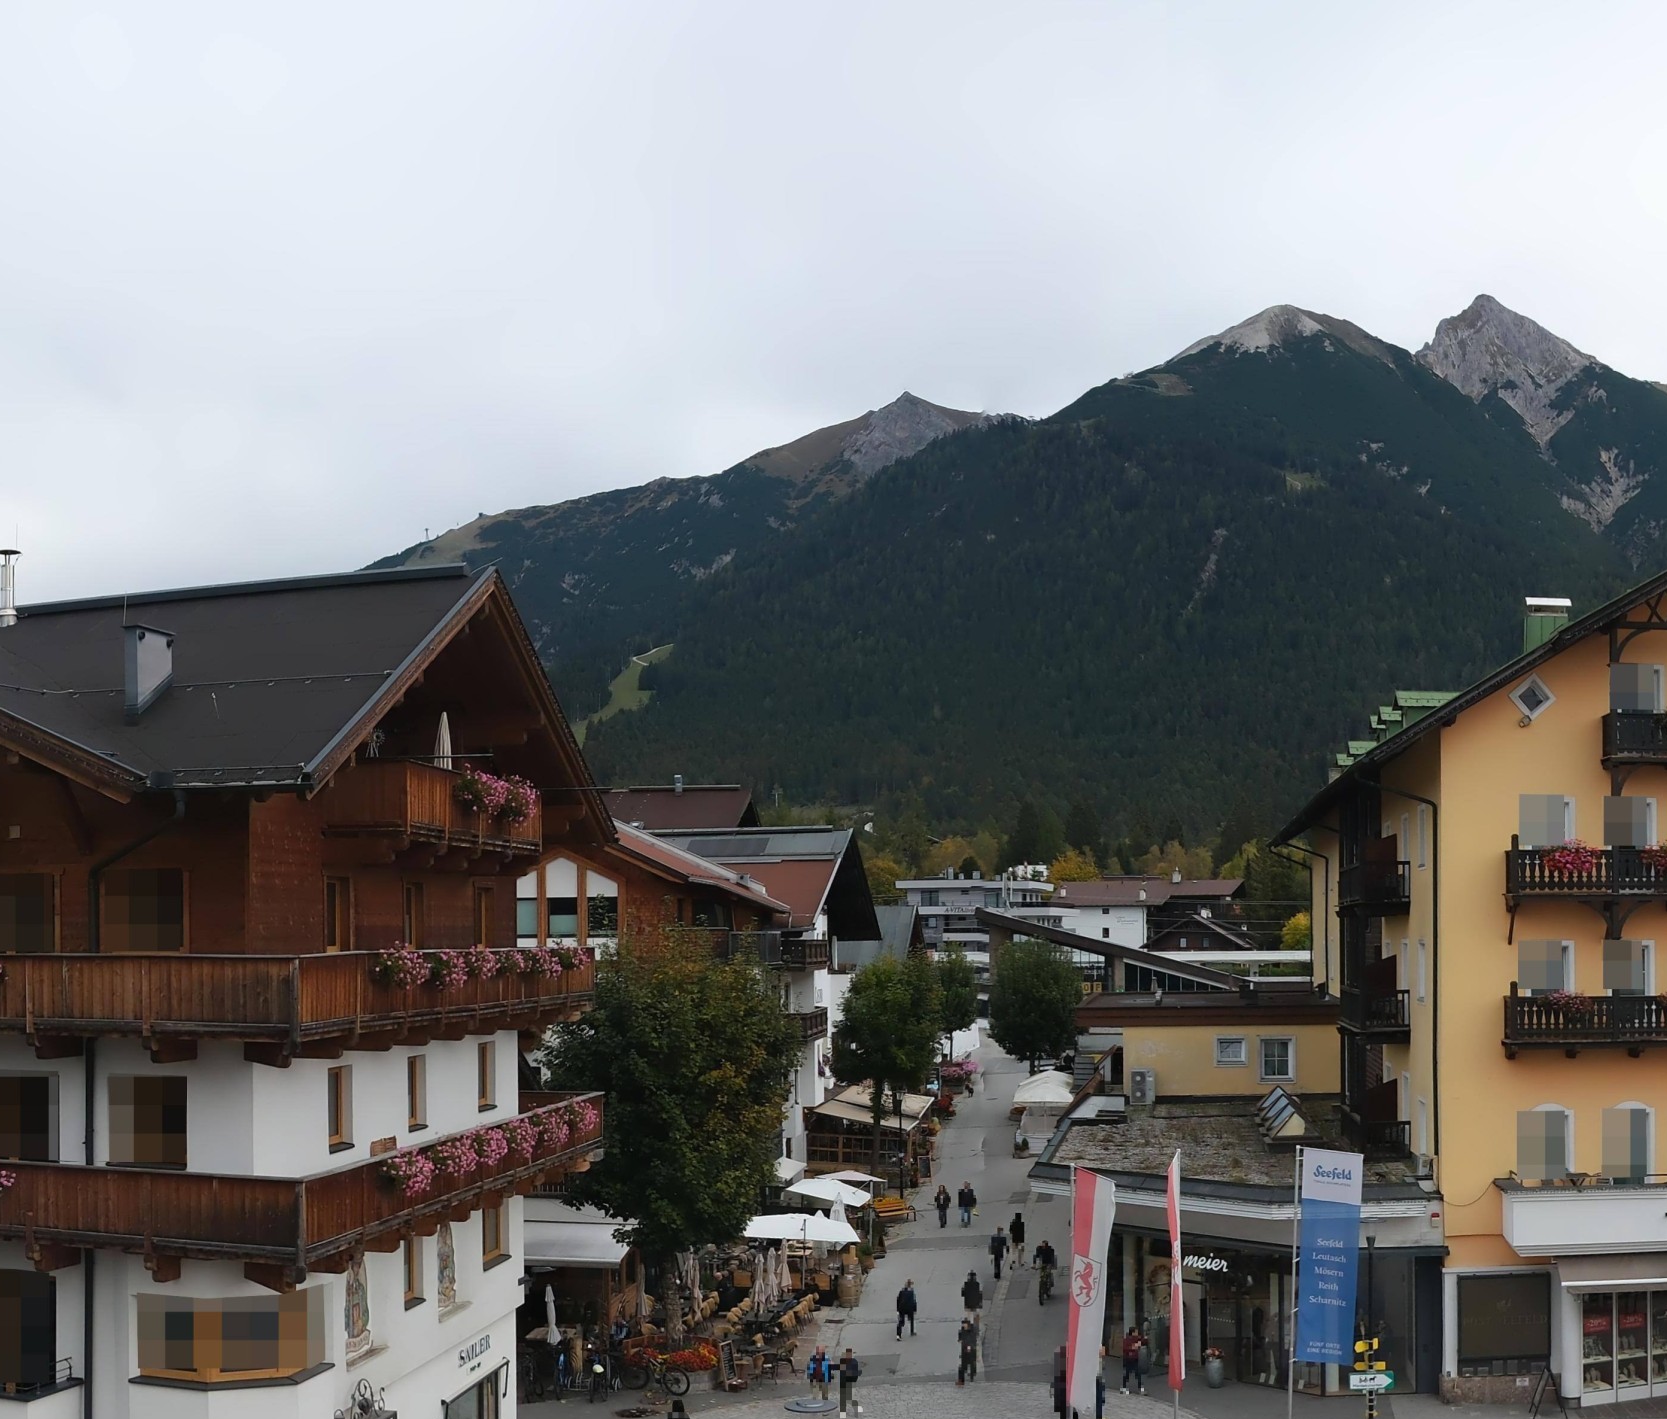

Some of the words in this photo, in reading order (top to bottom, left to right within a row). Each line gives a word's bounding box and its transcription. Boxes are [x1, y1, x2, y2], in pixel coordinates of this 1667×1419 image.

[1313, 1164, 1352, 1181] Seefeld
[1317, 1238, 1344, 1249] Seefeld
[1182, 1252, 1229, 1273] meier
[1312, 1251, 1347, 1263] Leutasch
[1314, 1265, 1344, 1278] Mösern
[1318, 1280, 1339, 1291] Reith
[1309, 1295, 1347, 1307] Scharnitz
[458, 1333, 492, 1368] SAILER
